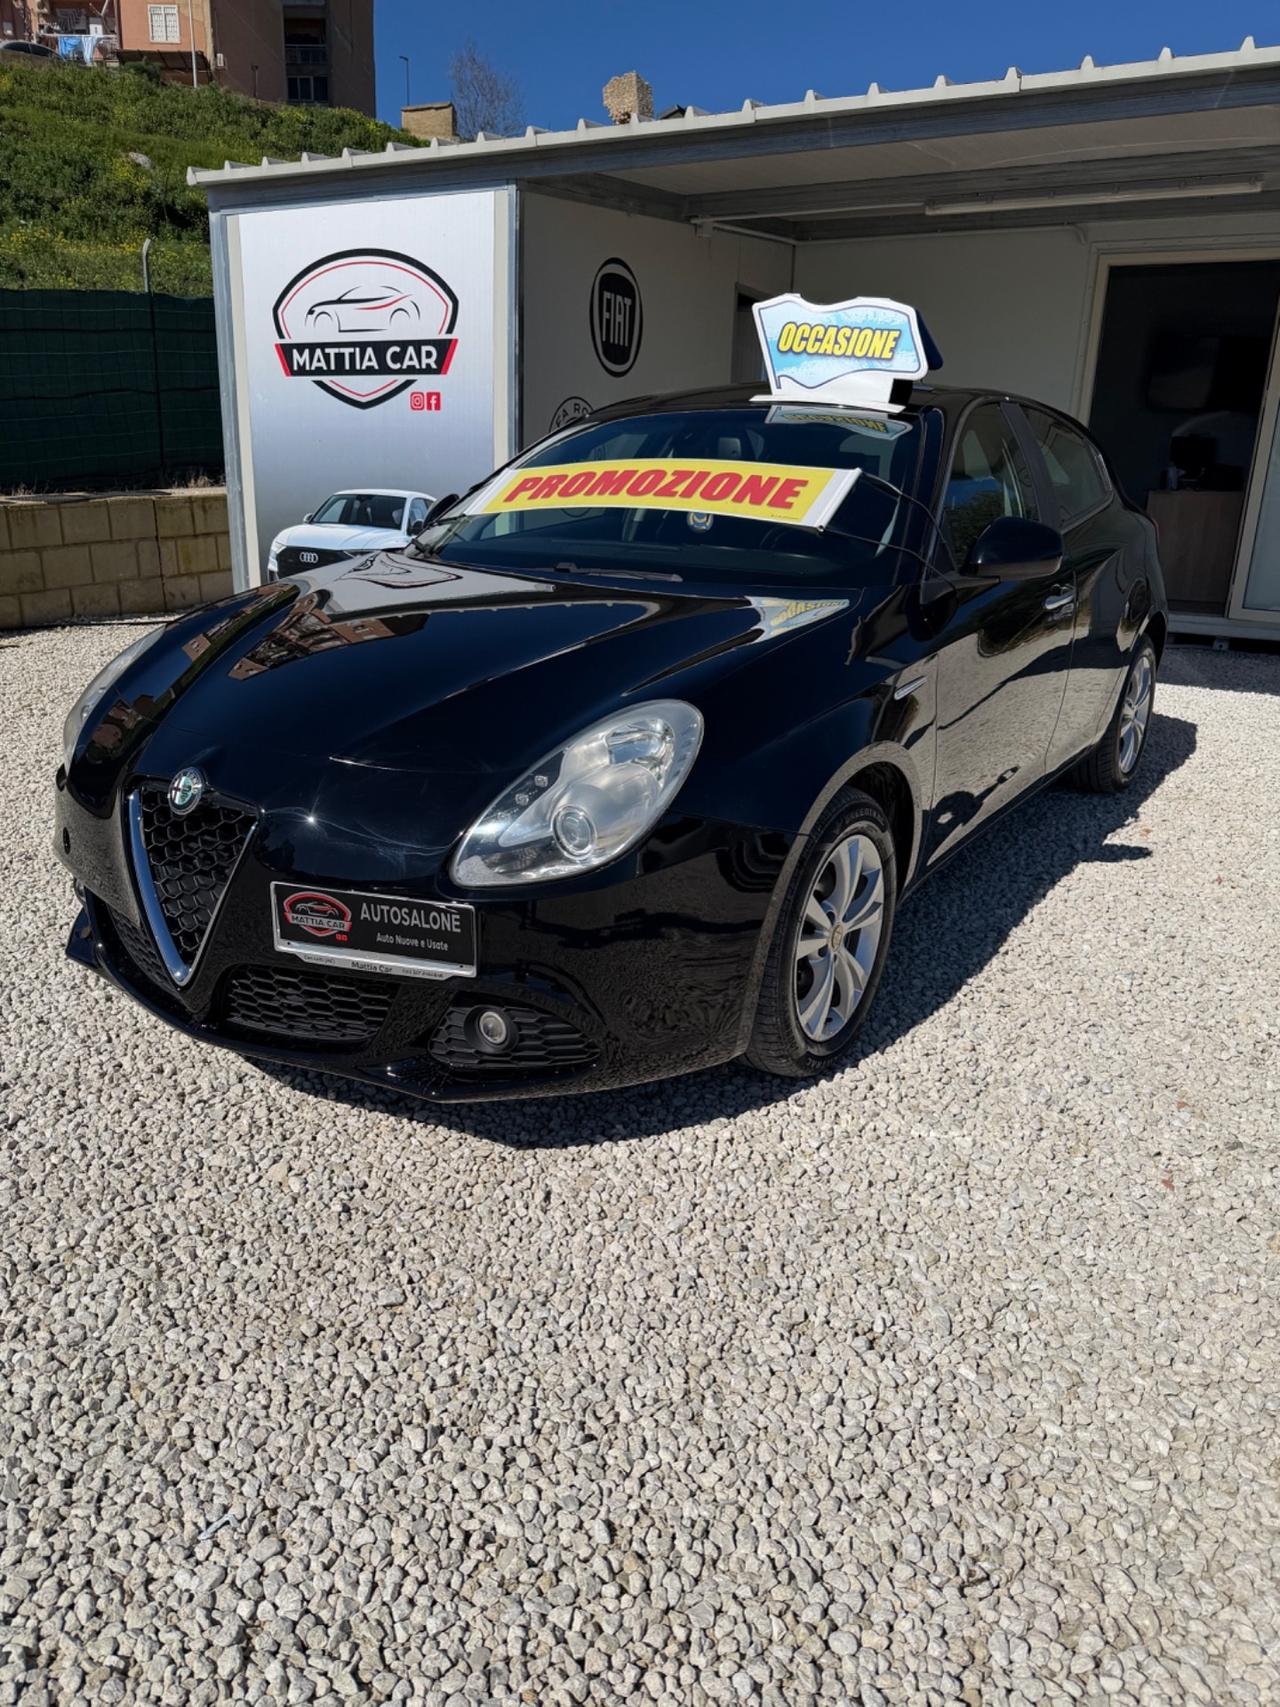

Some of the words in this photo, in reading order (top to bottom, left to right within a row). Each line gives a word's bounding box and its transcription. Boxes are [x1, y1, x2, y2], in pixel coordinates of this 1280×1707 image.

[603, 291, 632, 347] FIAT
[777, 320, 902, 360] OCCASIONE
[292, 346, 379, 371] MATTIA
[386, 345, 438, 370] CAR
[503, 468, 810, 509] PROMOZIONE
[291, 914, 325, 927] MATTIA
[326, 918, 346, 930] CAR
[360, 902, 461, 933] AUTOSALONE
[376, 932, 394, 944] Auto
[395, 935, 419, 948] Nuove
[426, 939, 449, 951] Usate
[351, 961, 378, 973] Mattia
[379, 964, 393, 974] Car
